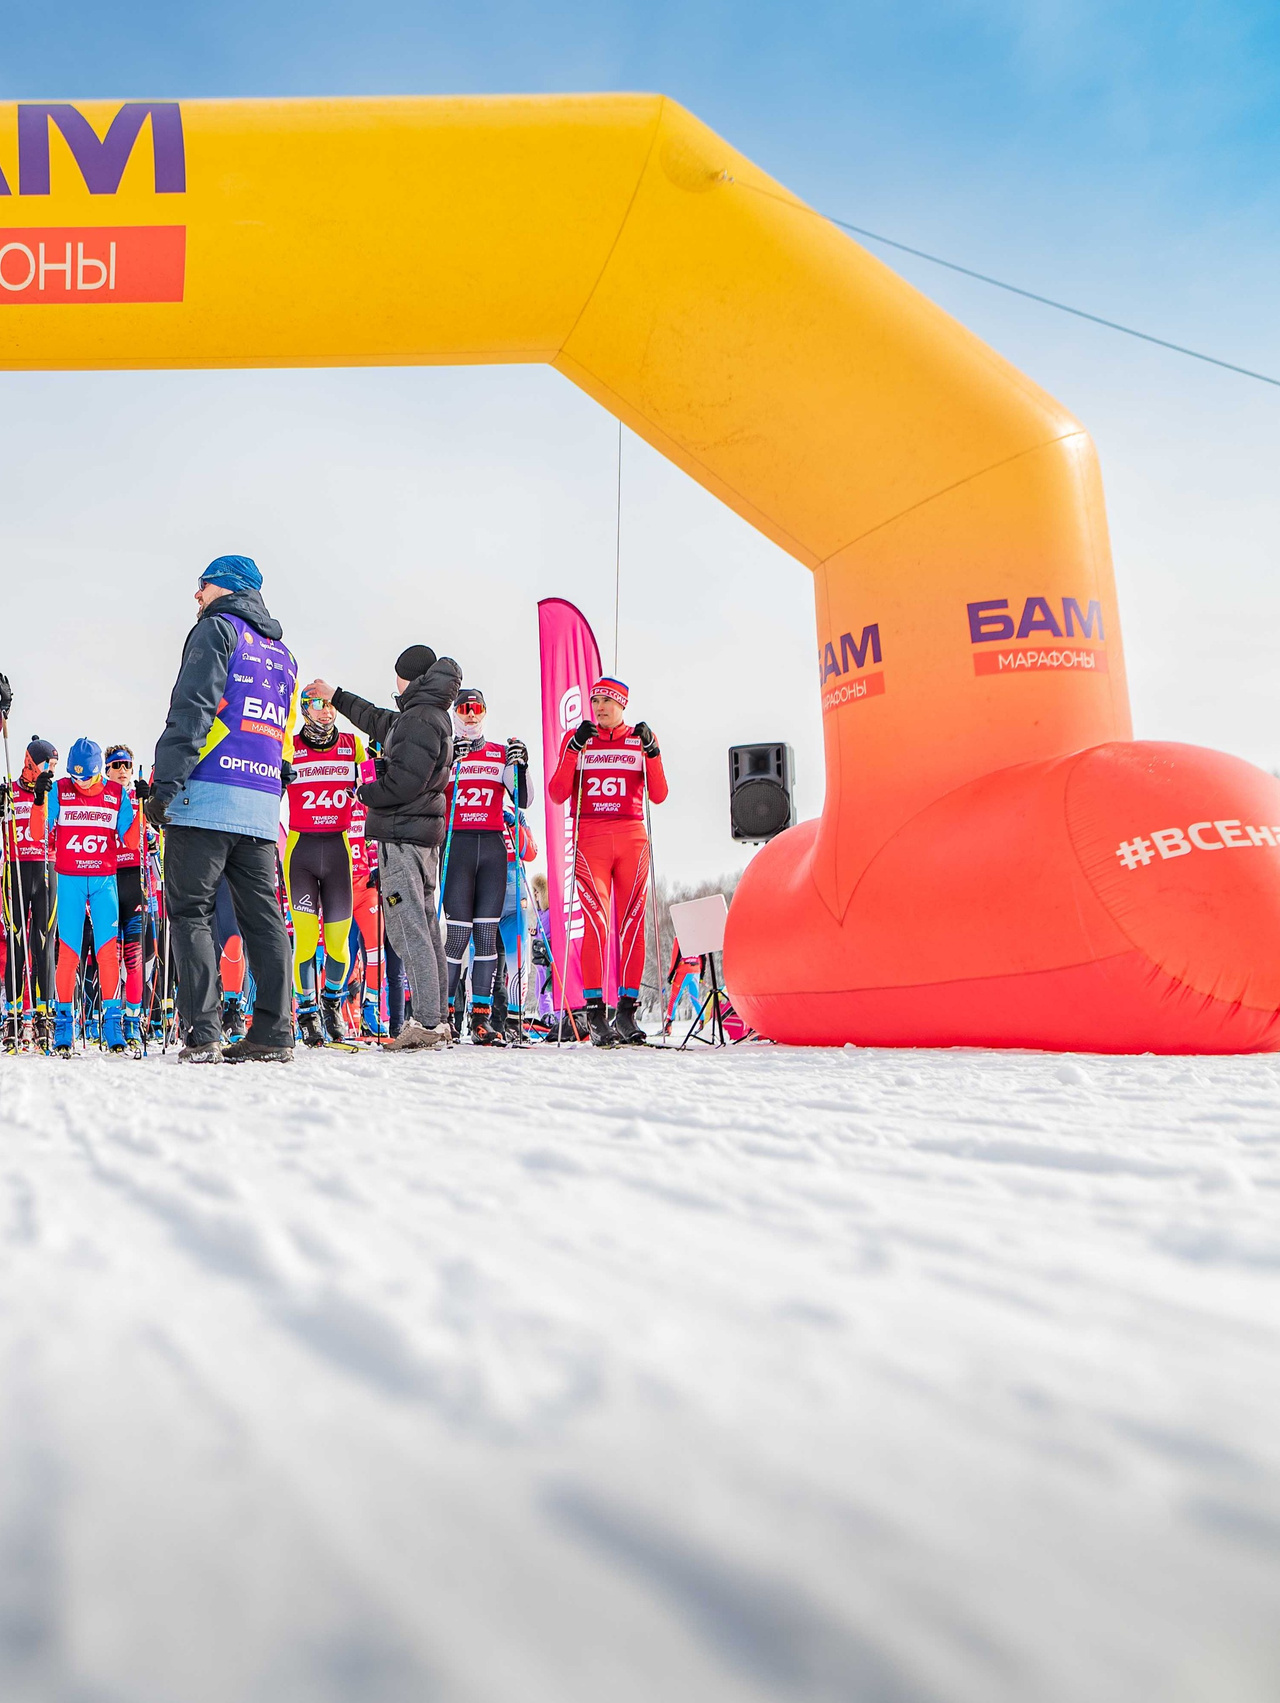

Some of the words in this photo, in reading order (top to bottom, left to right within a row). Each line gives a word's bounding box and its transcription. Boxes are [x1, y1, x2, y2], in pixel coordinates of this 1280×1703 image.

[967, 597, 1105, 643] БАМ
[820, 623, 882, 687] АМ
[998, 650, 1095, 670] МАРАФОНЫ
[299, 766, 349, 778] ТЕМЕРСО
[587, 777, 627, 797] 261
[301, 789, 347, 809] 240
[451, 788, 494, 807] 427
[64, 811, 113, 822] ТЕМЕРСО
[65, 835, 108, 853] 467
